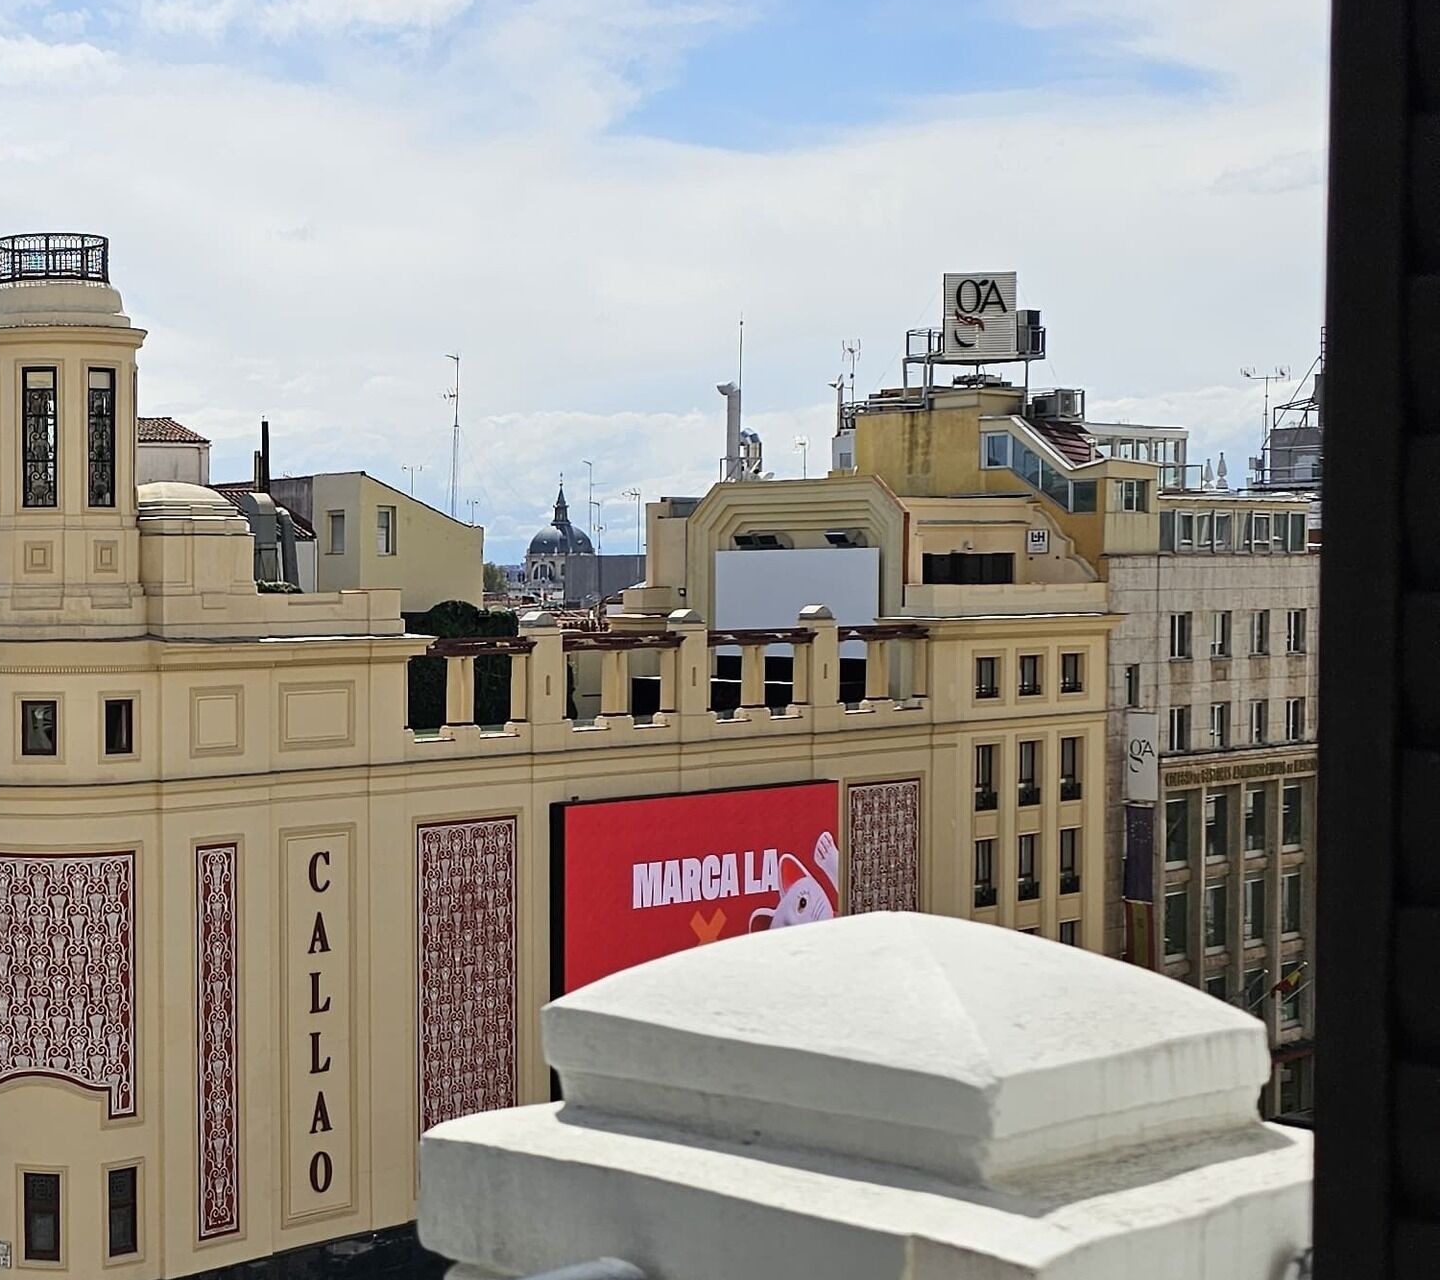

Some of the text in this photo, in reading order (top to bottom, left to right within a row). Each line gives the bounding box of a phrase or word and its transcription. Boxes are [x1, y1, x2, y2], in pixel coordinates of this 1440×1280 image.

[632, 848, 780, 910] MARCA LA
[307, 850, 333, 1193] CALLAO
